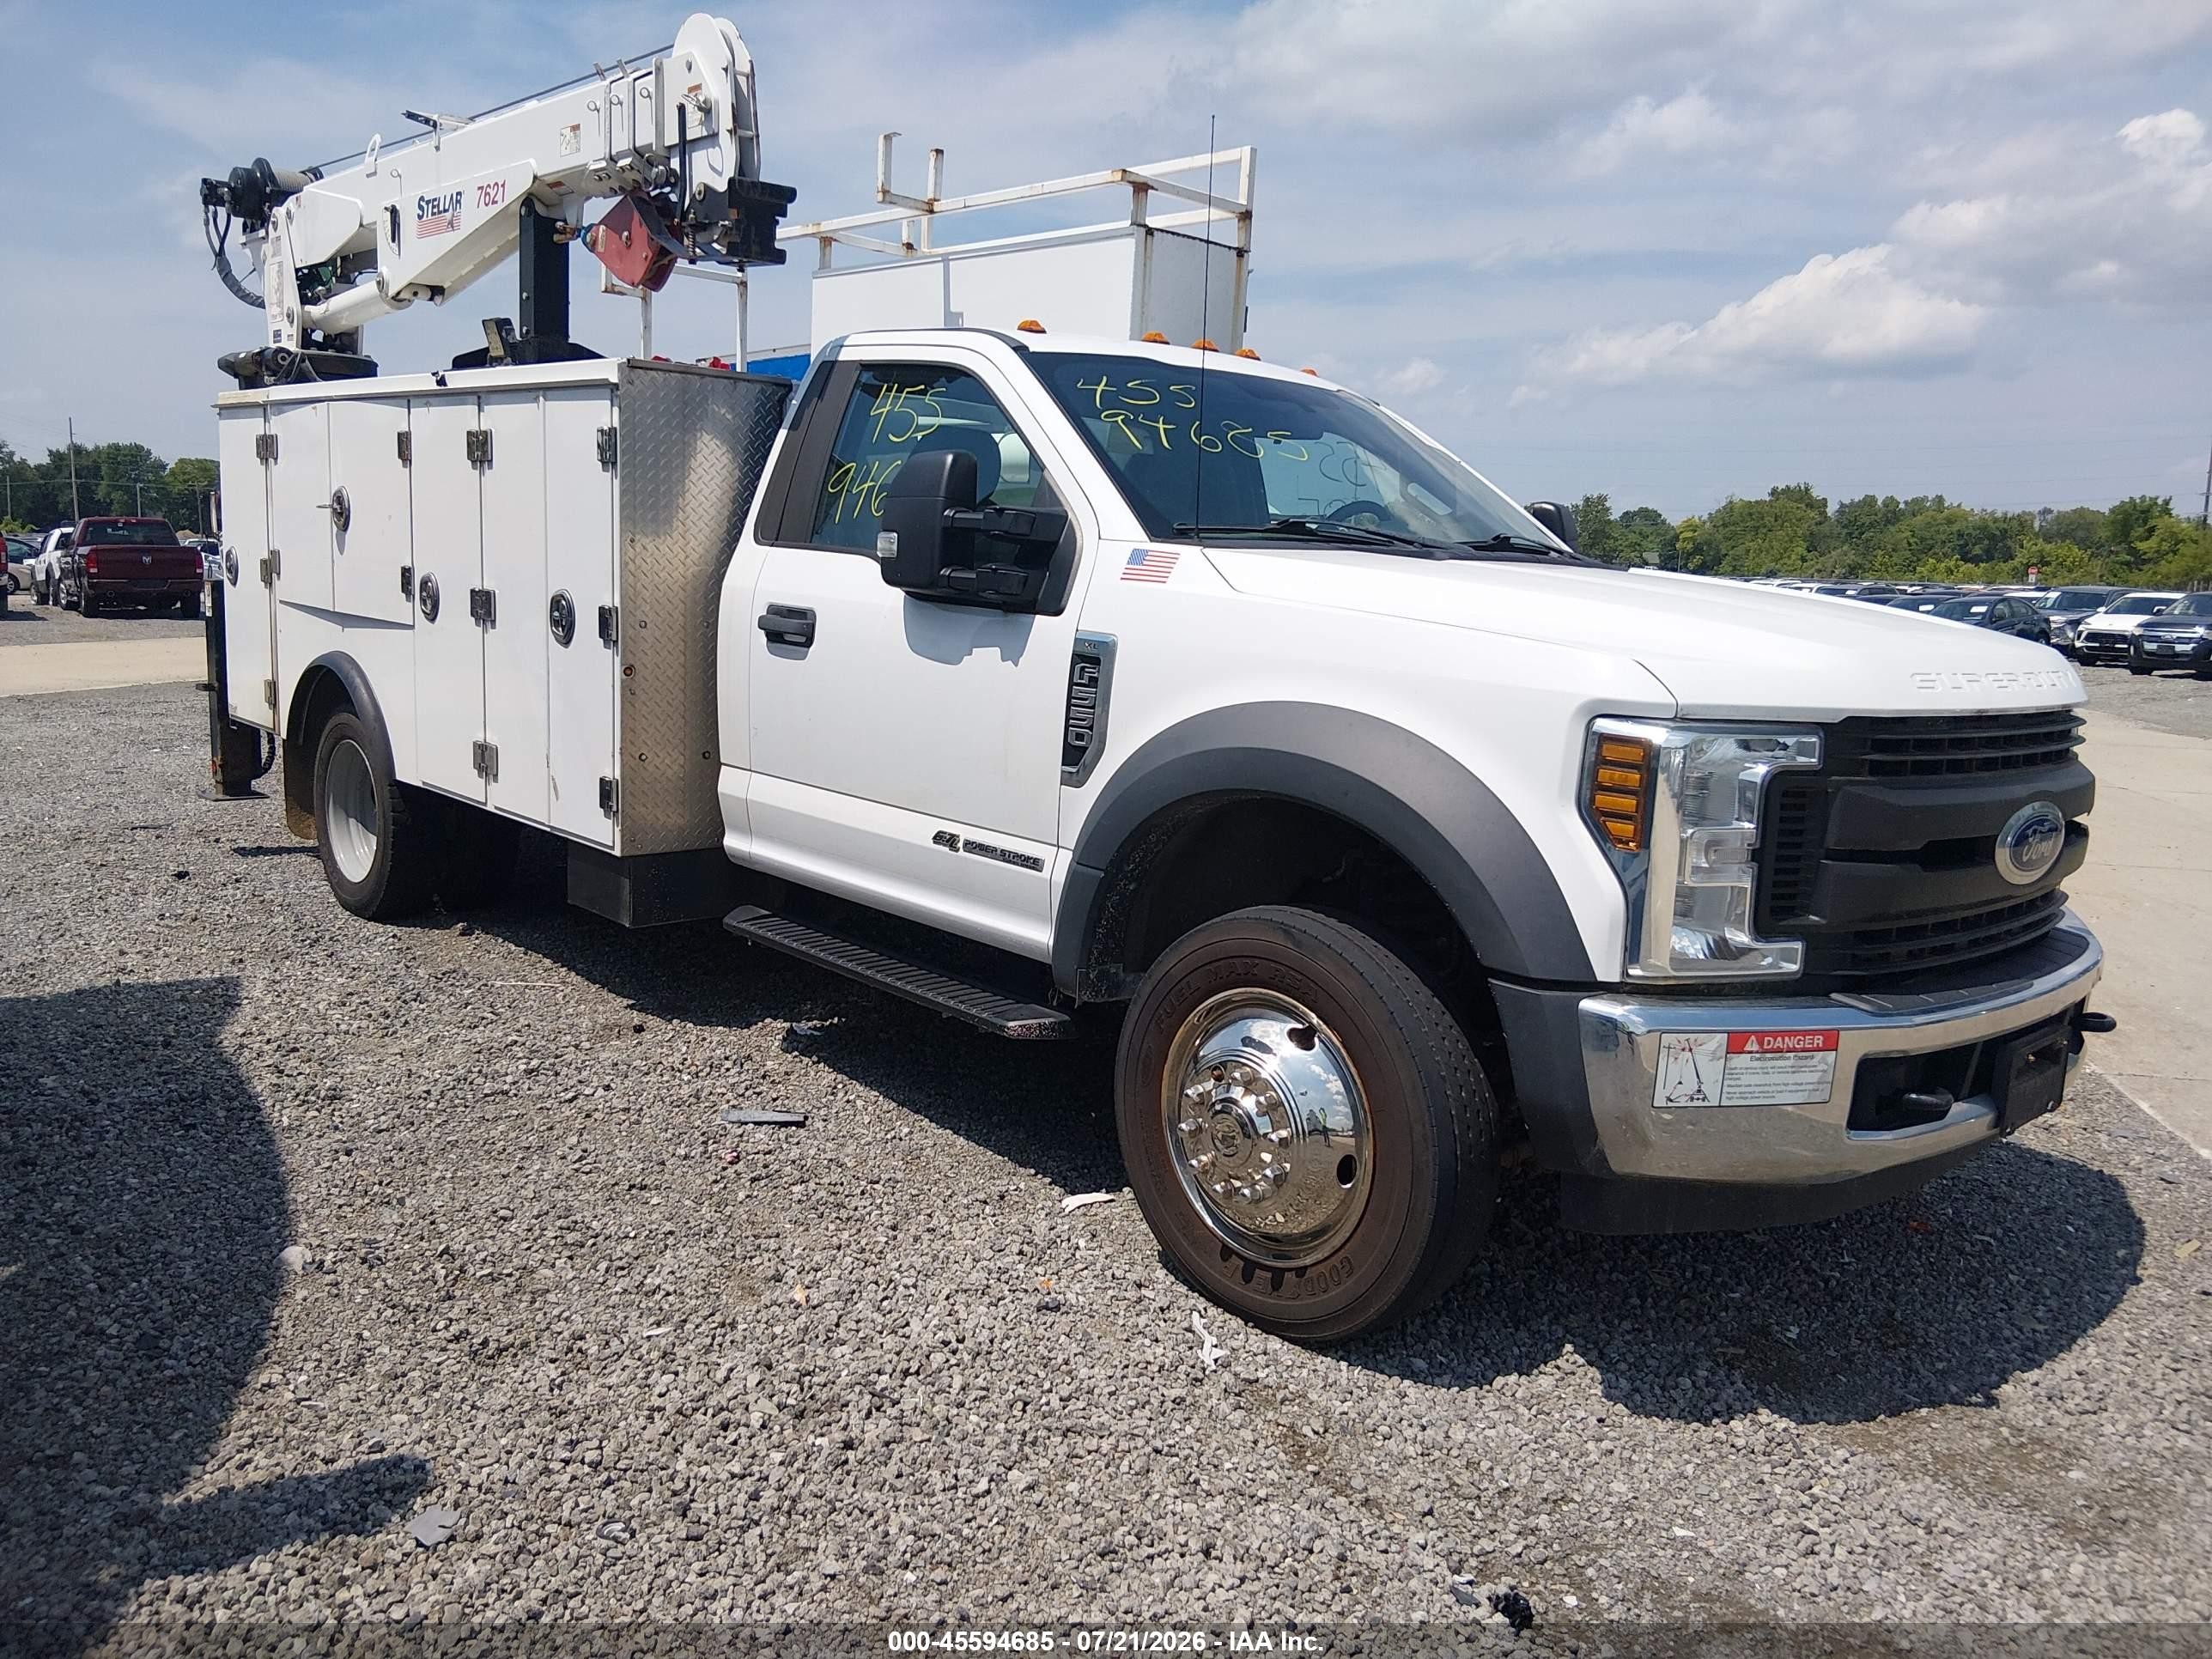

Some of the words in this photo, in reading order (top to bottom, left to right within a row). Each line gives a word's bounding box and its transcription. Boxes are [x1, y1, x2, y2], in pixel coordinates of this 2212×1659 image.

[417, 191, 463, 221] STELLAR
[477, 179, 507, 209] 7621
[1077, 376, 1196, 409] 455
[870, 383, 946, 443] 455
[1101, 410, 1308, 460] 94685
[963, 839, 998, 854] POWER
[1000, 848, 1041, 866] STROKE
[2022, 824, 2056, 862] Ford
[1206, 960, 1259, 984] MAX
[1763, 1036, 1824, 1049] DANGER
